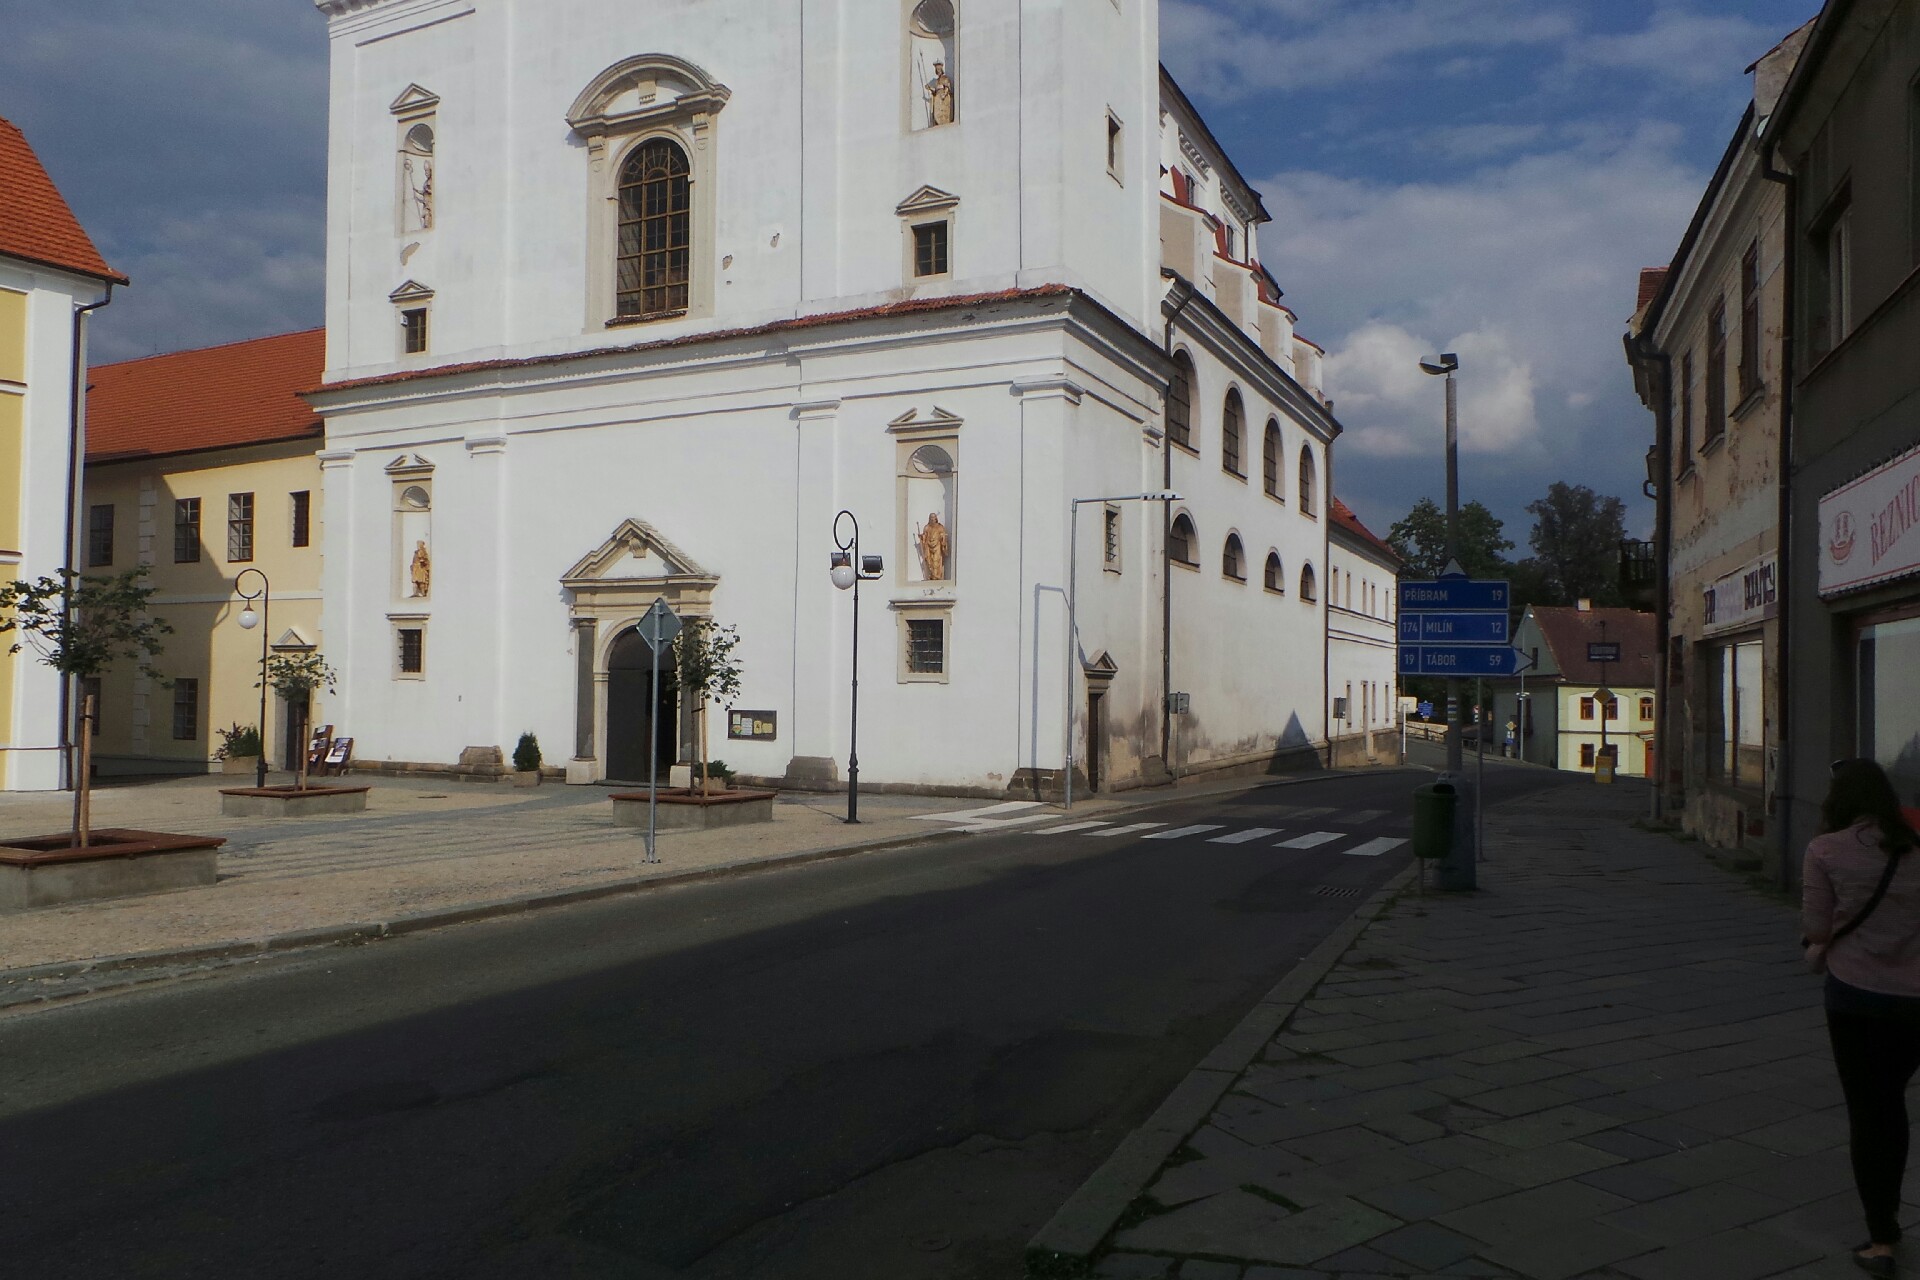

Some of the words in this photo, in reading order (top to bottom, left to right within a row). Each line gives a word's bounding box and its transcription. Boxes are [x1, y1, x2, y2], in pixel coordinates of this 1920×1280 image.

[1404, 587, 1448, 601] PŘÍBRAM
[1492, 590, 1503, 601] 19
[1402, 622, 1418, 633] 174
[1425, 619, 1453, 633] MILÍN
[1491, 622, 1502, 633] 12
[1404, 654, 1415, 665] 19
[1426, 651, 1456, 666] TÁBOR
[1489, 655, 1502, 666] 59
